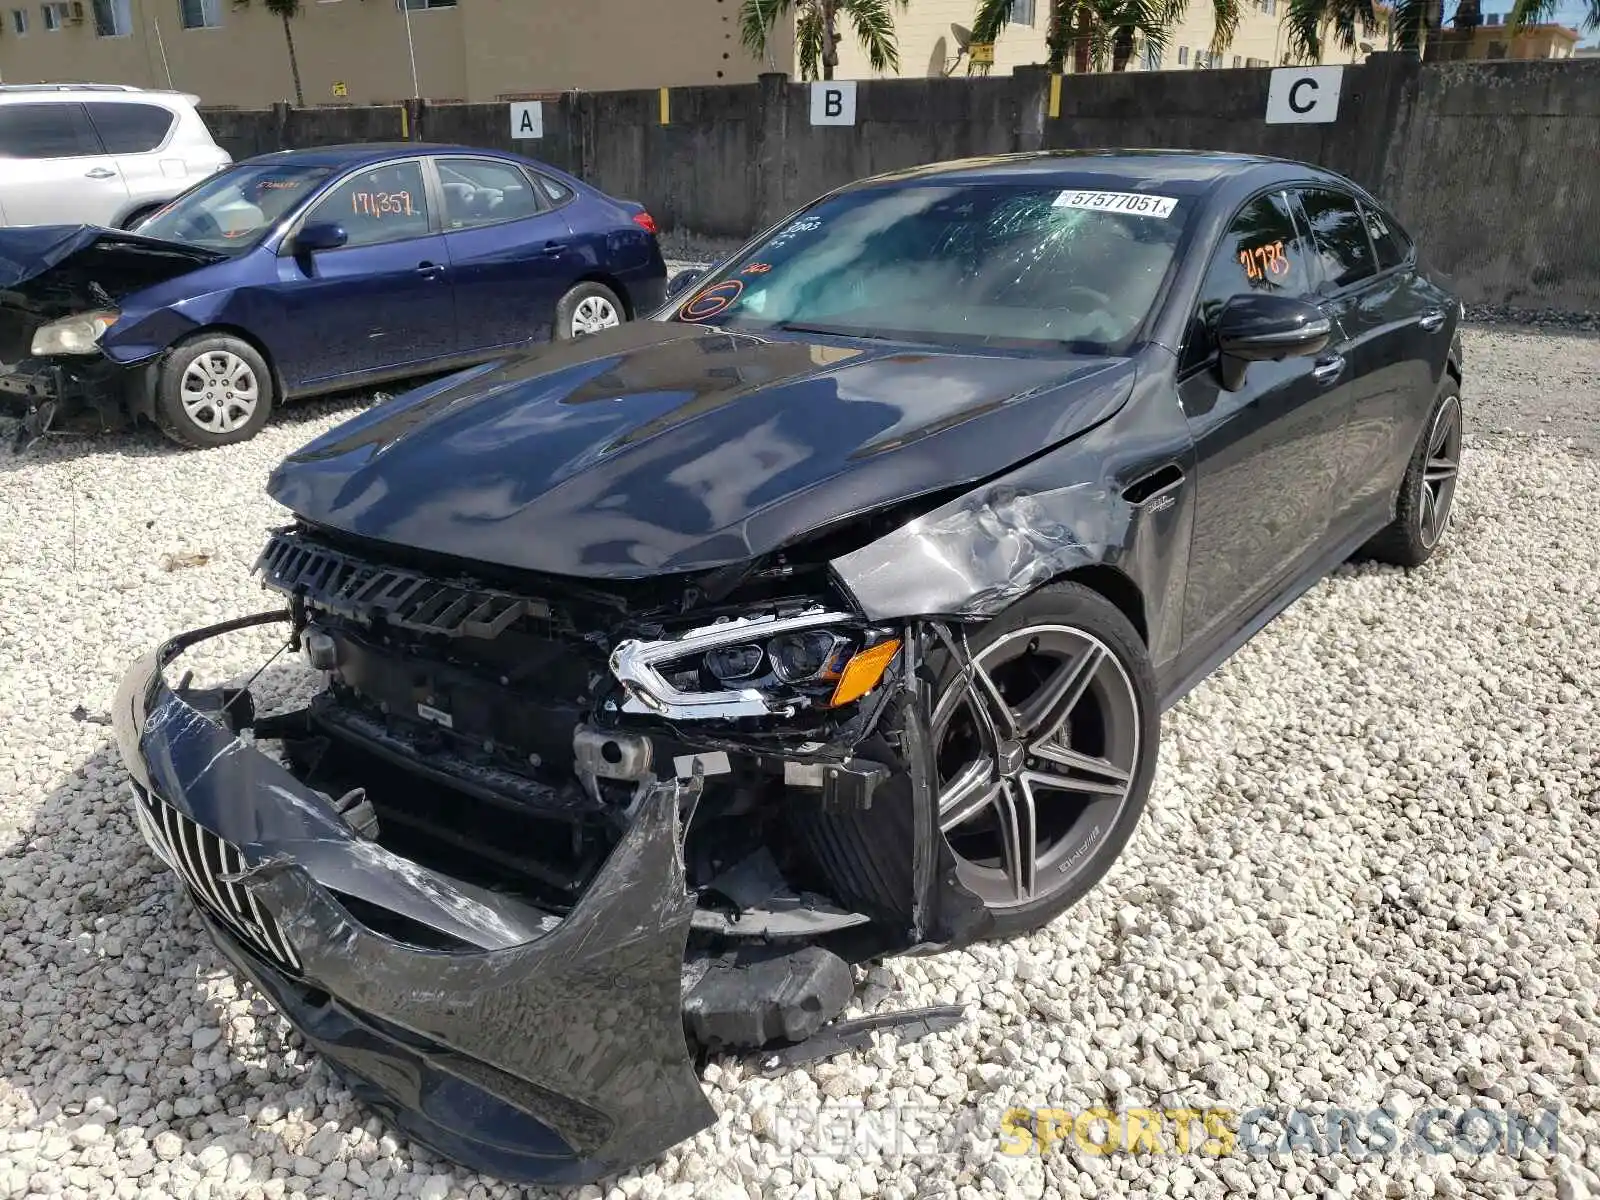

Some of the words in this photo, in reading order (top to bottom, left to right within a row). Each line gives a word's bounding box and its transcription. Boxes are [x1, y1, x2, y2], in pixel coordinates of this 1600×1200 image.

[825, 89, 842, 117] B
[1288, 77, 1319, 114] C
[520, 109, 533, 132] A
